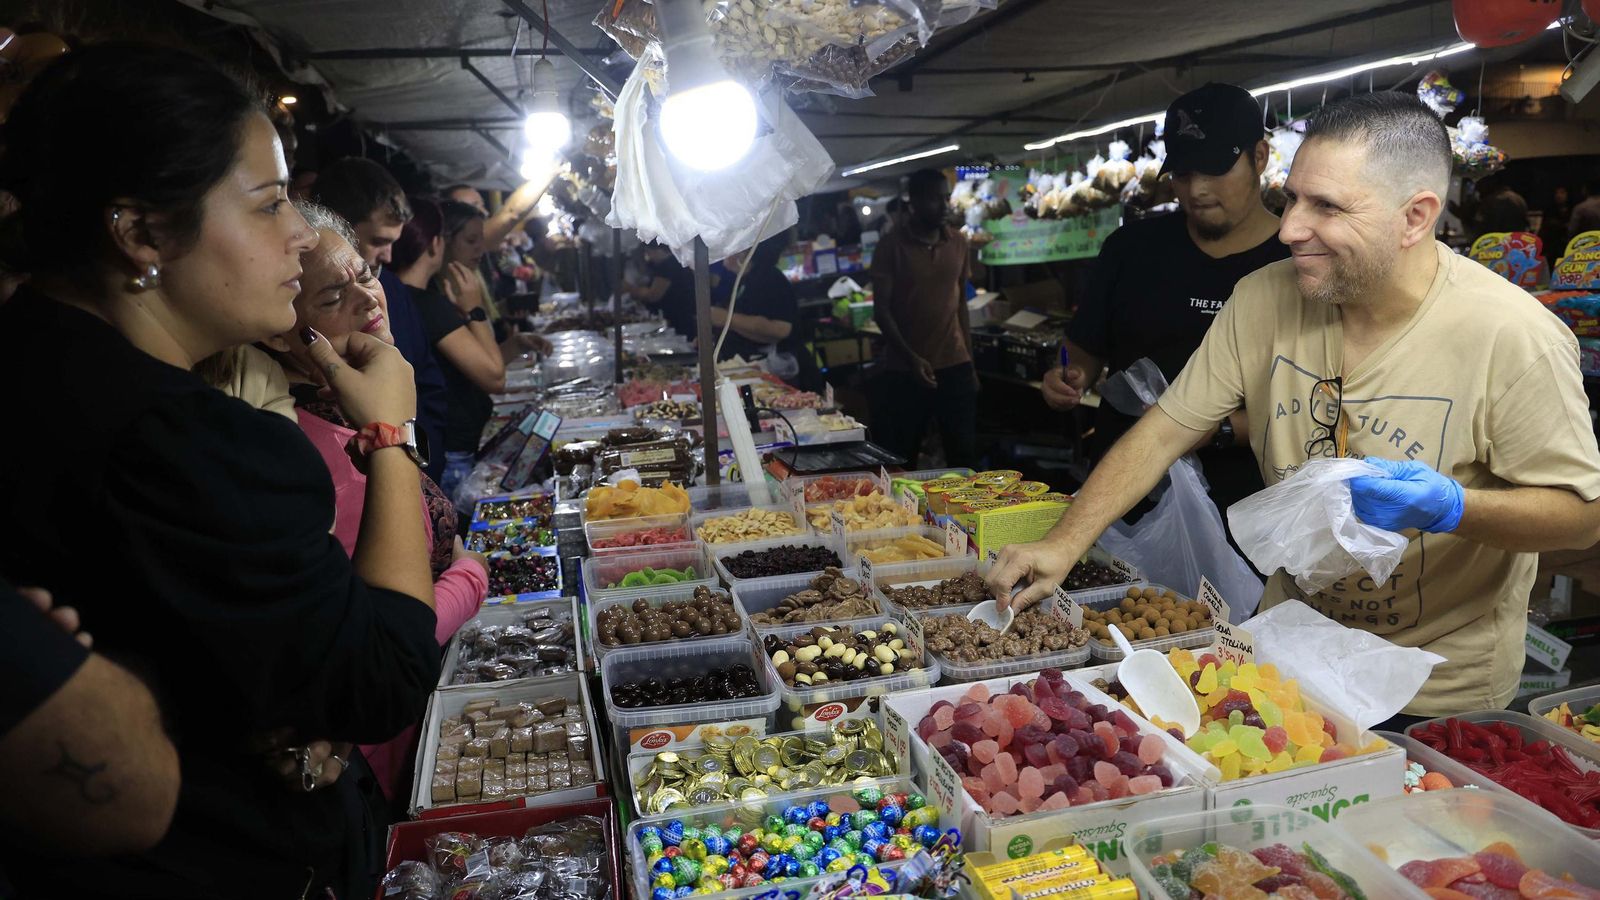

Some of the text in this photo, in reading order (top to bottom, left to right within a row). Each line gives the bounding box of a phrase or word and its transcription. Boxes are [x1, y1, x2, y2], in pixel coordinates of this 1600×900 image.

[1190, 297, 1209, 308] THE
[1276, 397, 1425, 461] ADETURE
[1311, 602, 1400, 626] INGS
[1350, 596, 1396, 611] NOT
[1525, 633, 1557, 656] ONELLE
[1520, 681, 1557, 690] ONELLE
[1285, 783, 1338, 808] Squisite
